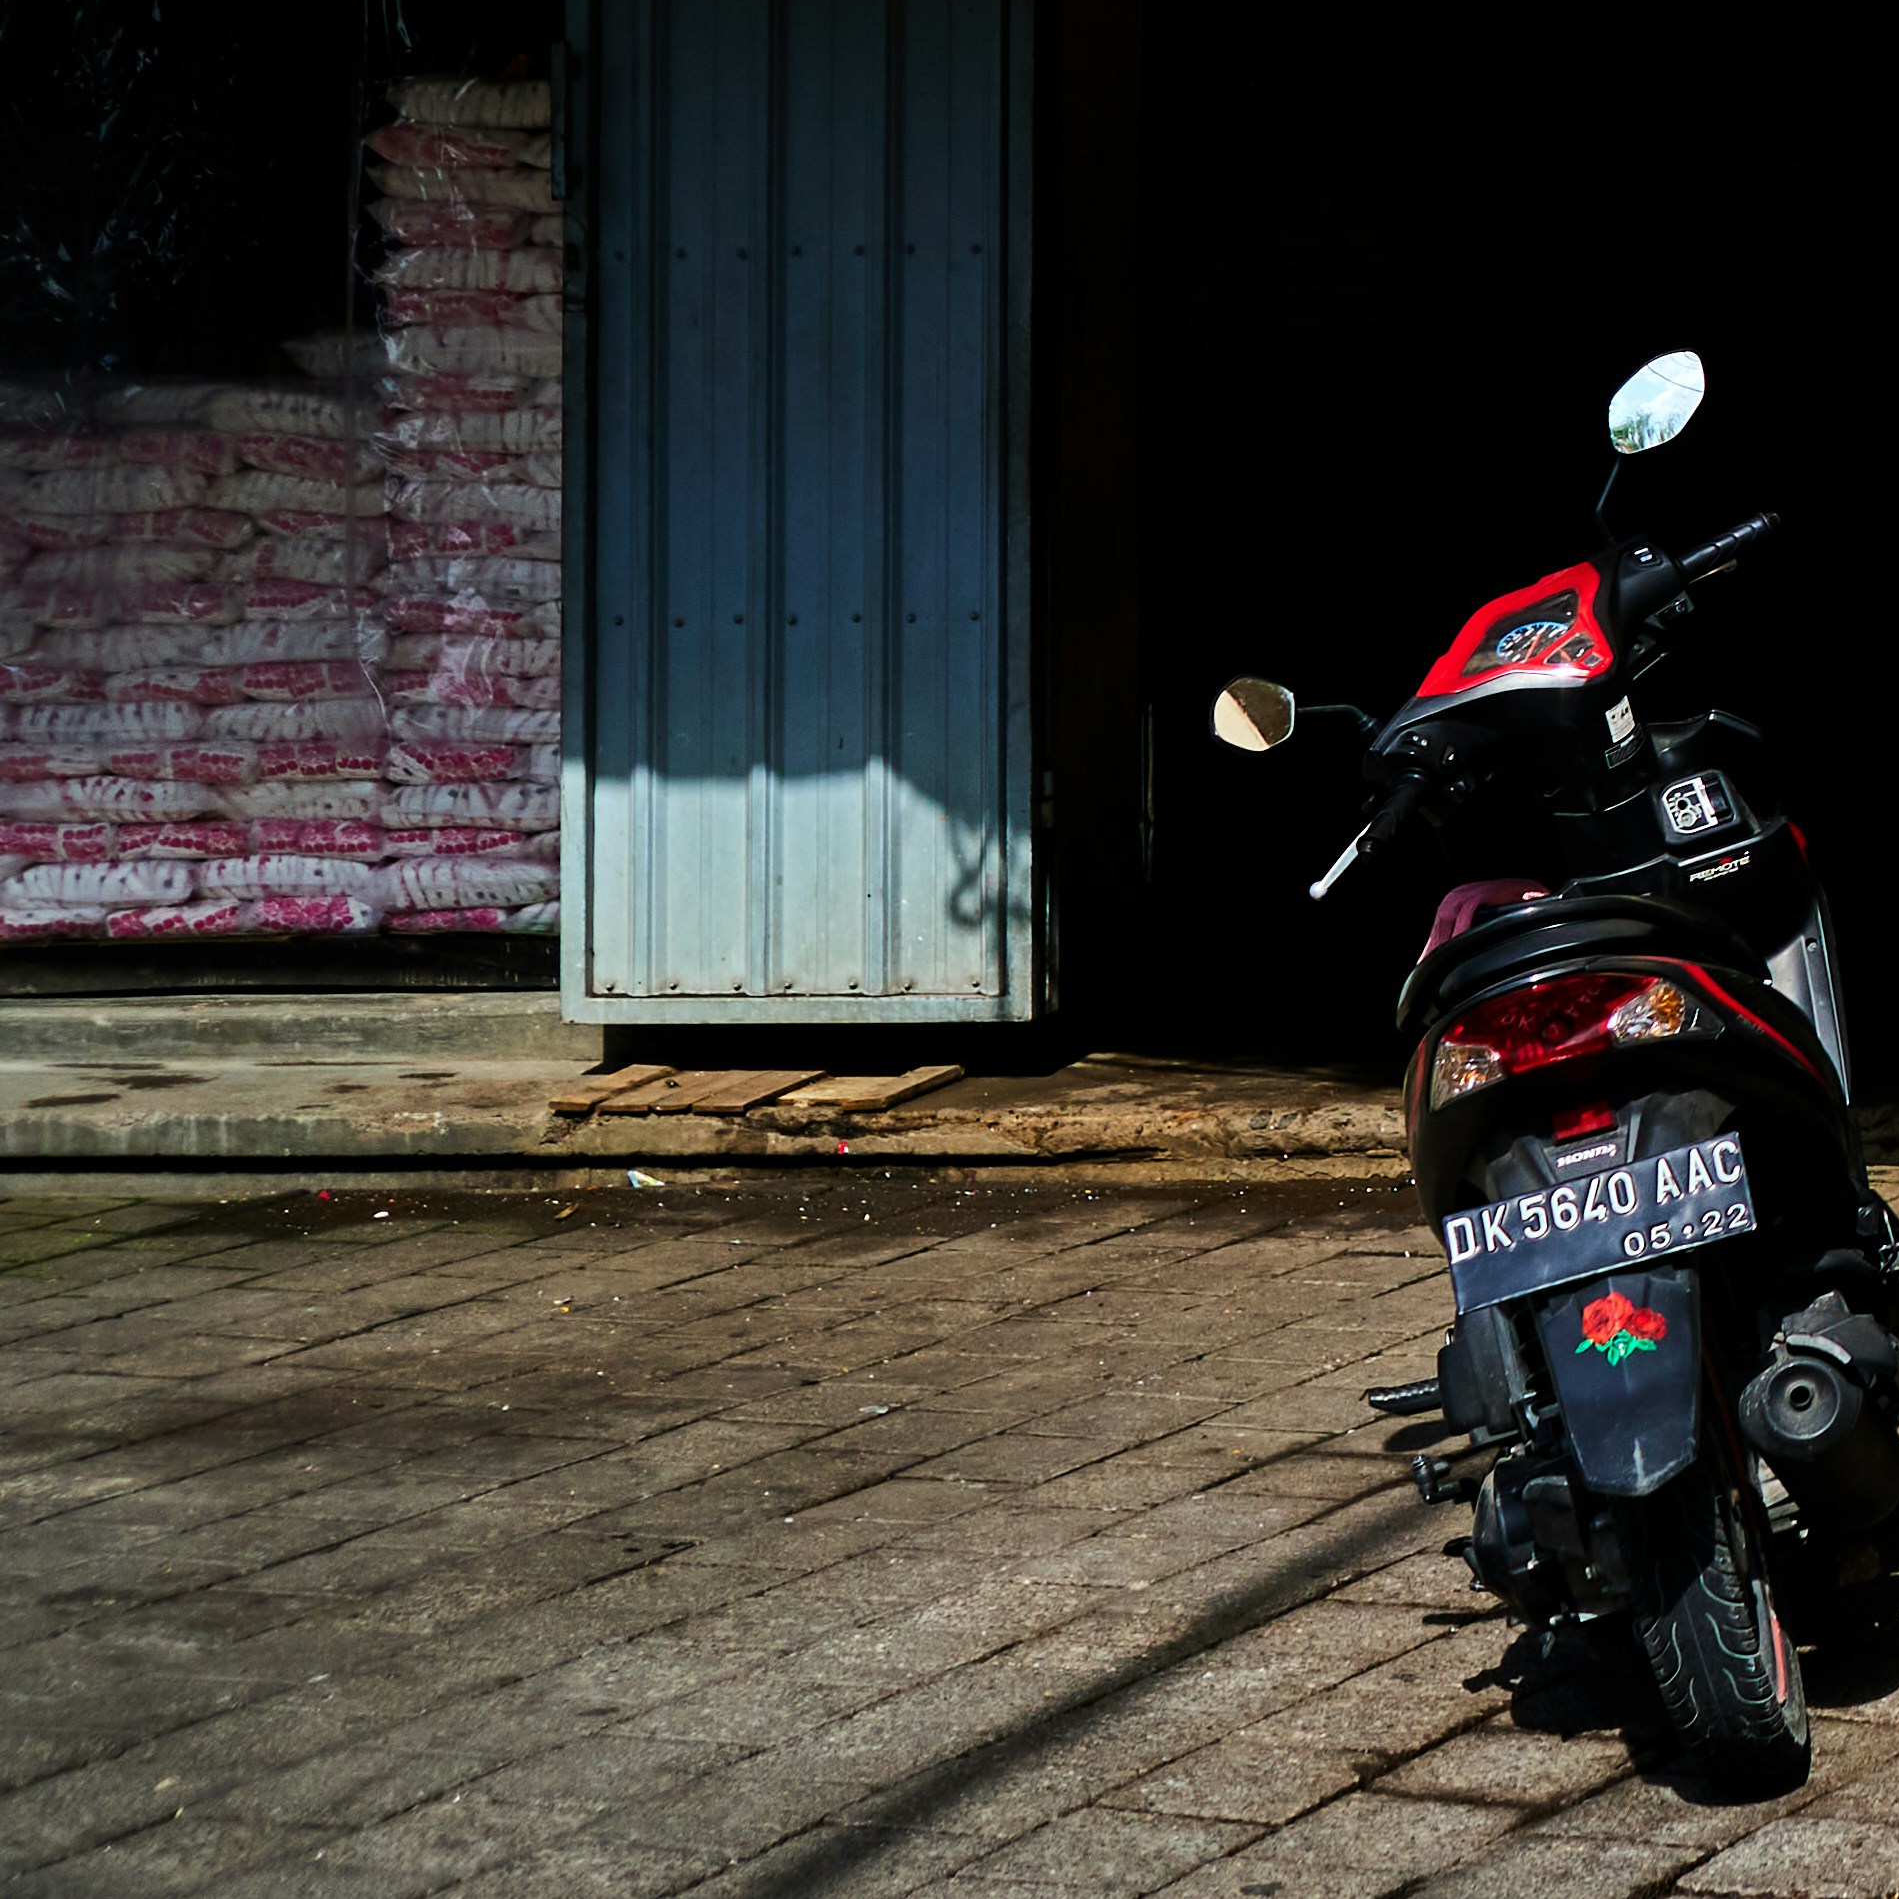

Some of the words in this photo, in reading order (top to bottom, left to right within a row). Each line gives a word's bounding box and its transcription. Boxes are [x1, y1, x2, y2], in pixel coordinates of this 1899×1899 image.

[1446, 1204, 1513, 1265] DK
[1519, 1170, 1638, 1240] 5640
[1655, 1139, 1743, 1204] AAC
